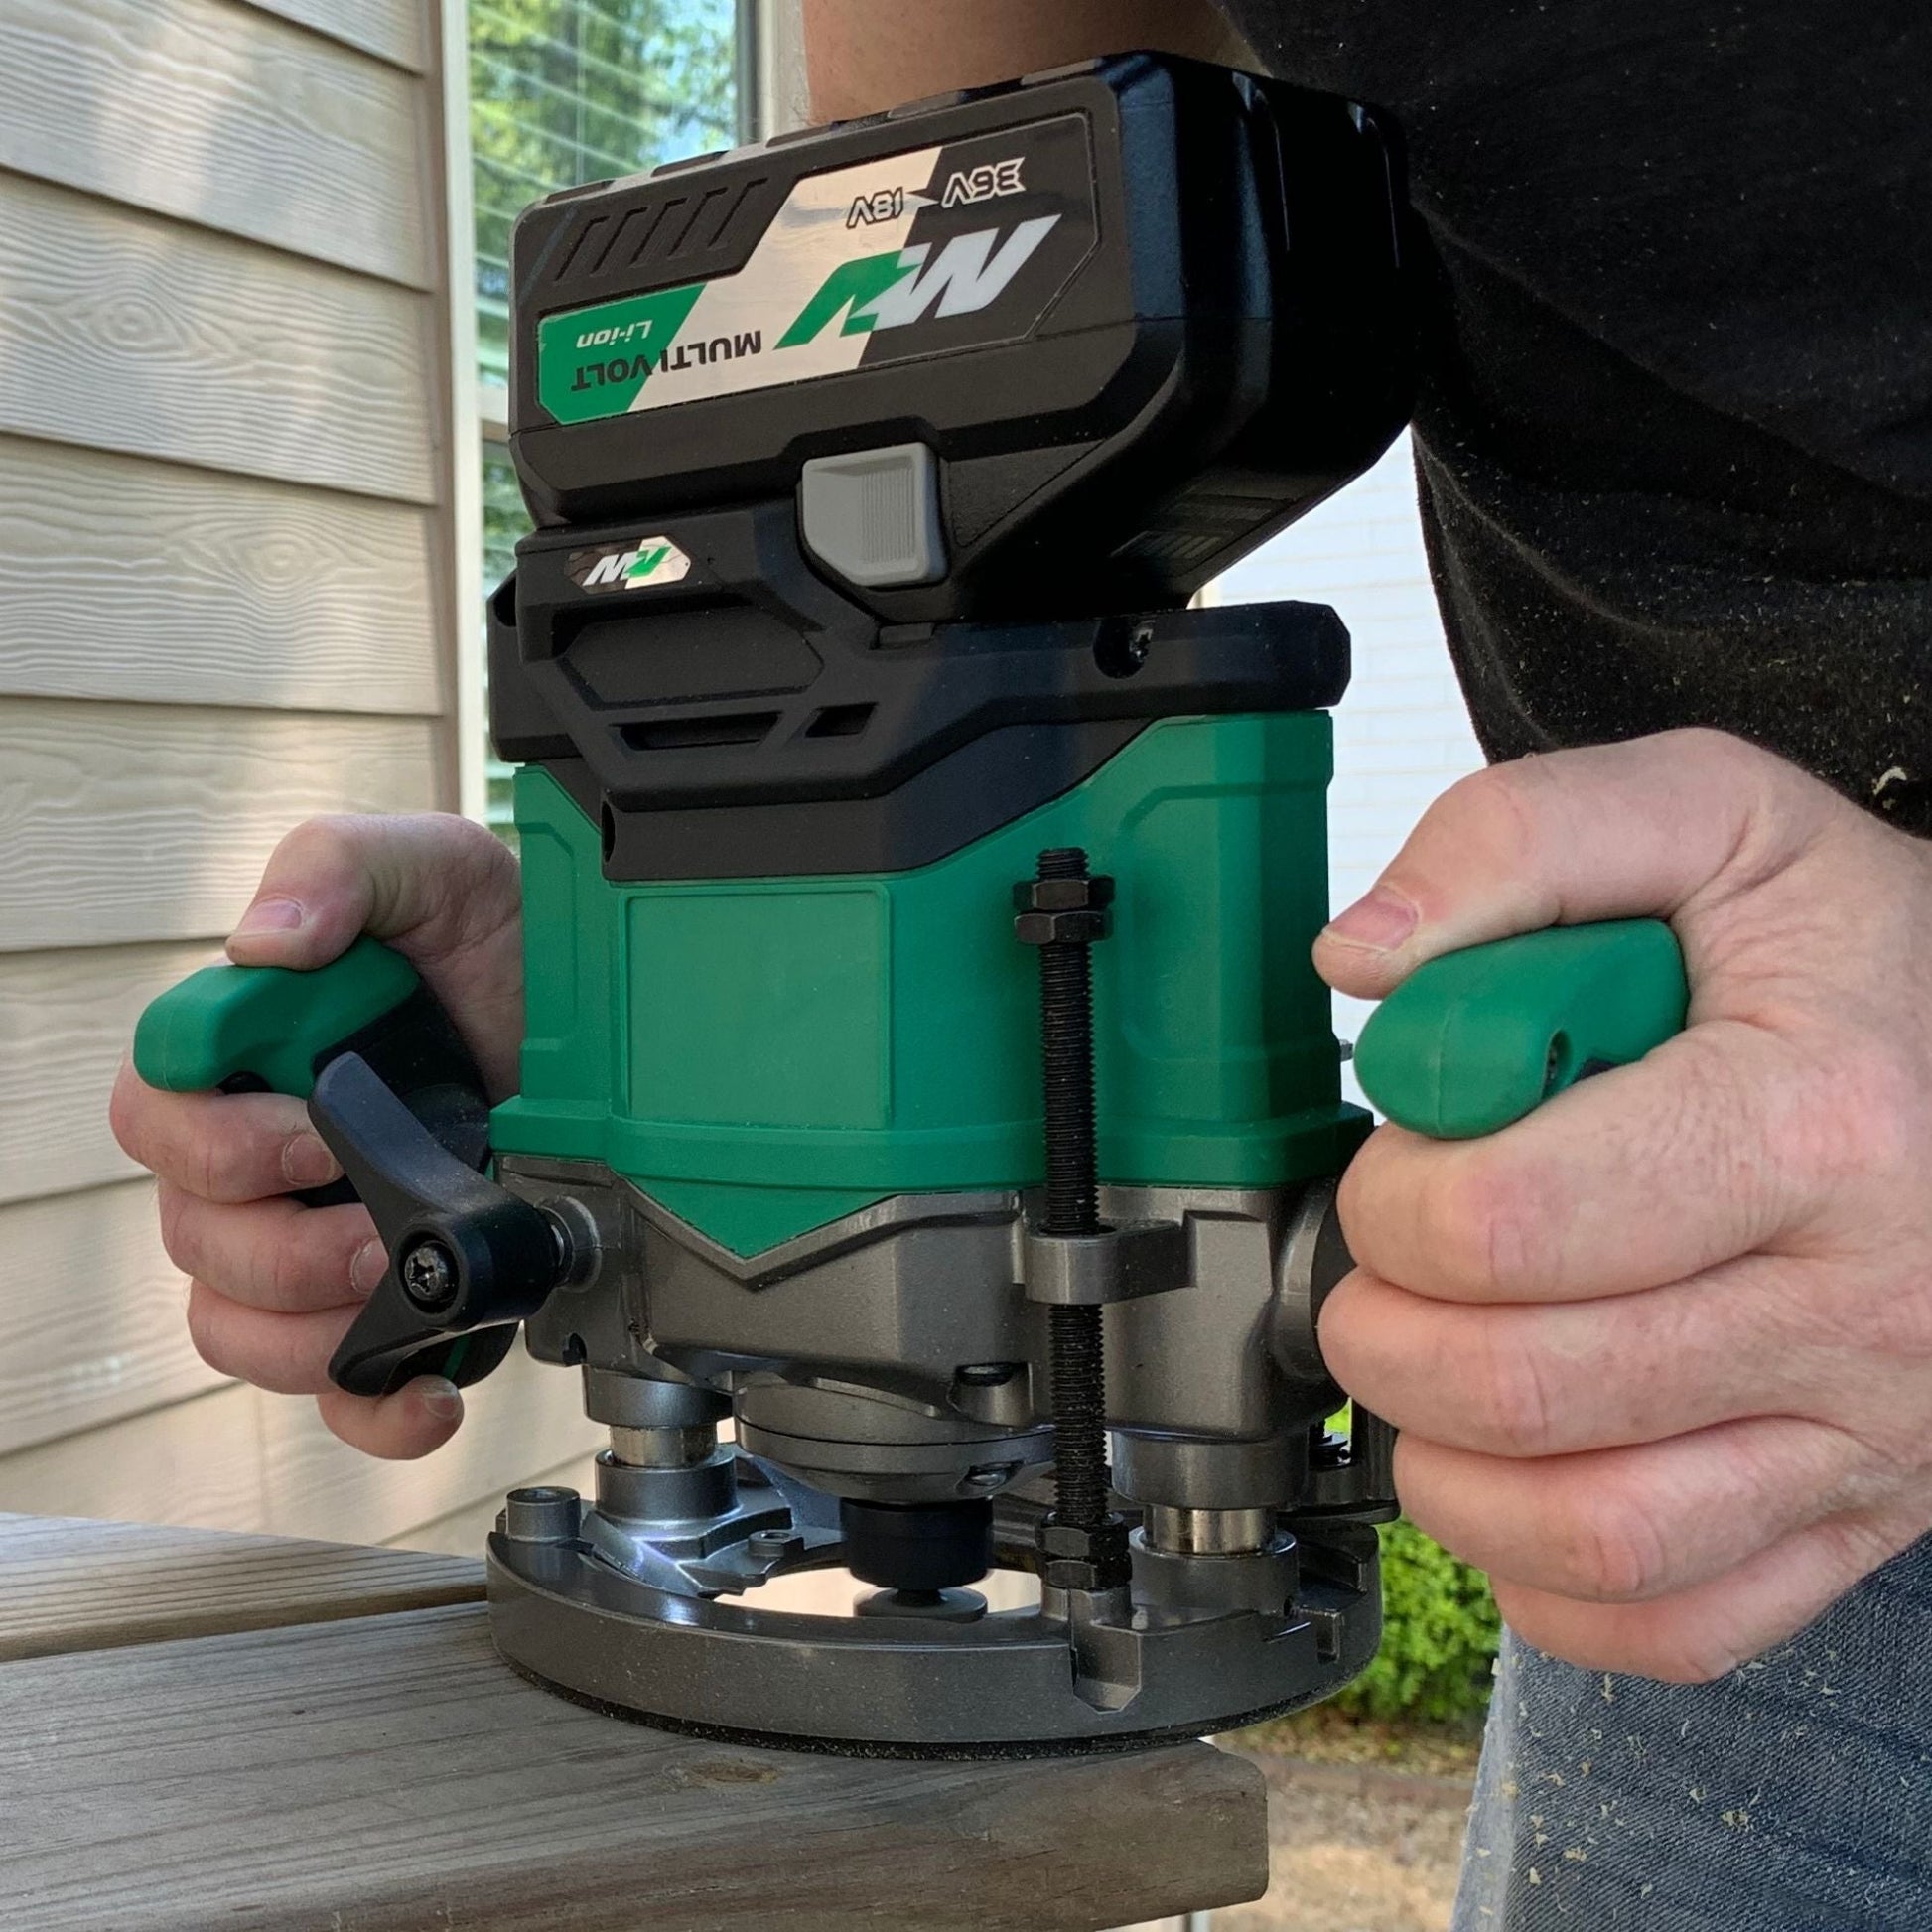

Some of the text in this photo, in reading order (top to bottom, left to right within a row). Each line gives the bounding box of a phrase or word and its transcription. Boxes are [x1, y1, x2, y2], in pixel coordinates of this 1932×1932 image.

[846, 156, 1026, 229] 36V 18V
[773, 213, 1062, 350] MV
[571, 330, 762, 392] MULTI VOLT
[576, 320, 652, 348] Li-ion
[582, 546, 671, 586] MV
